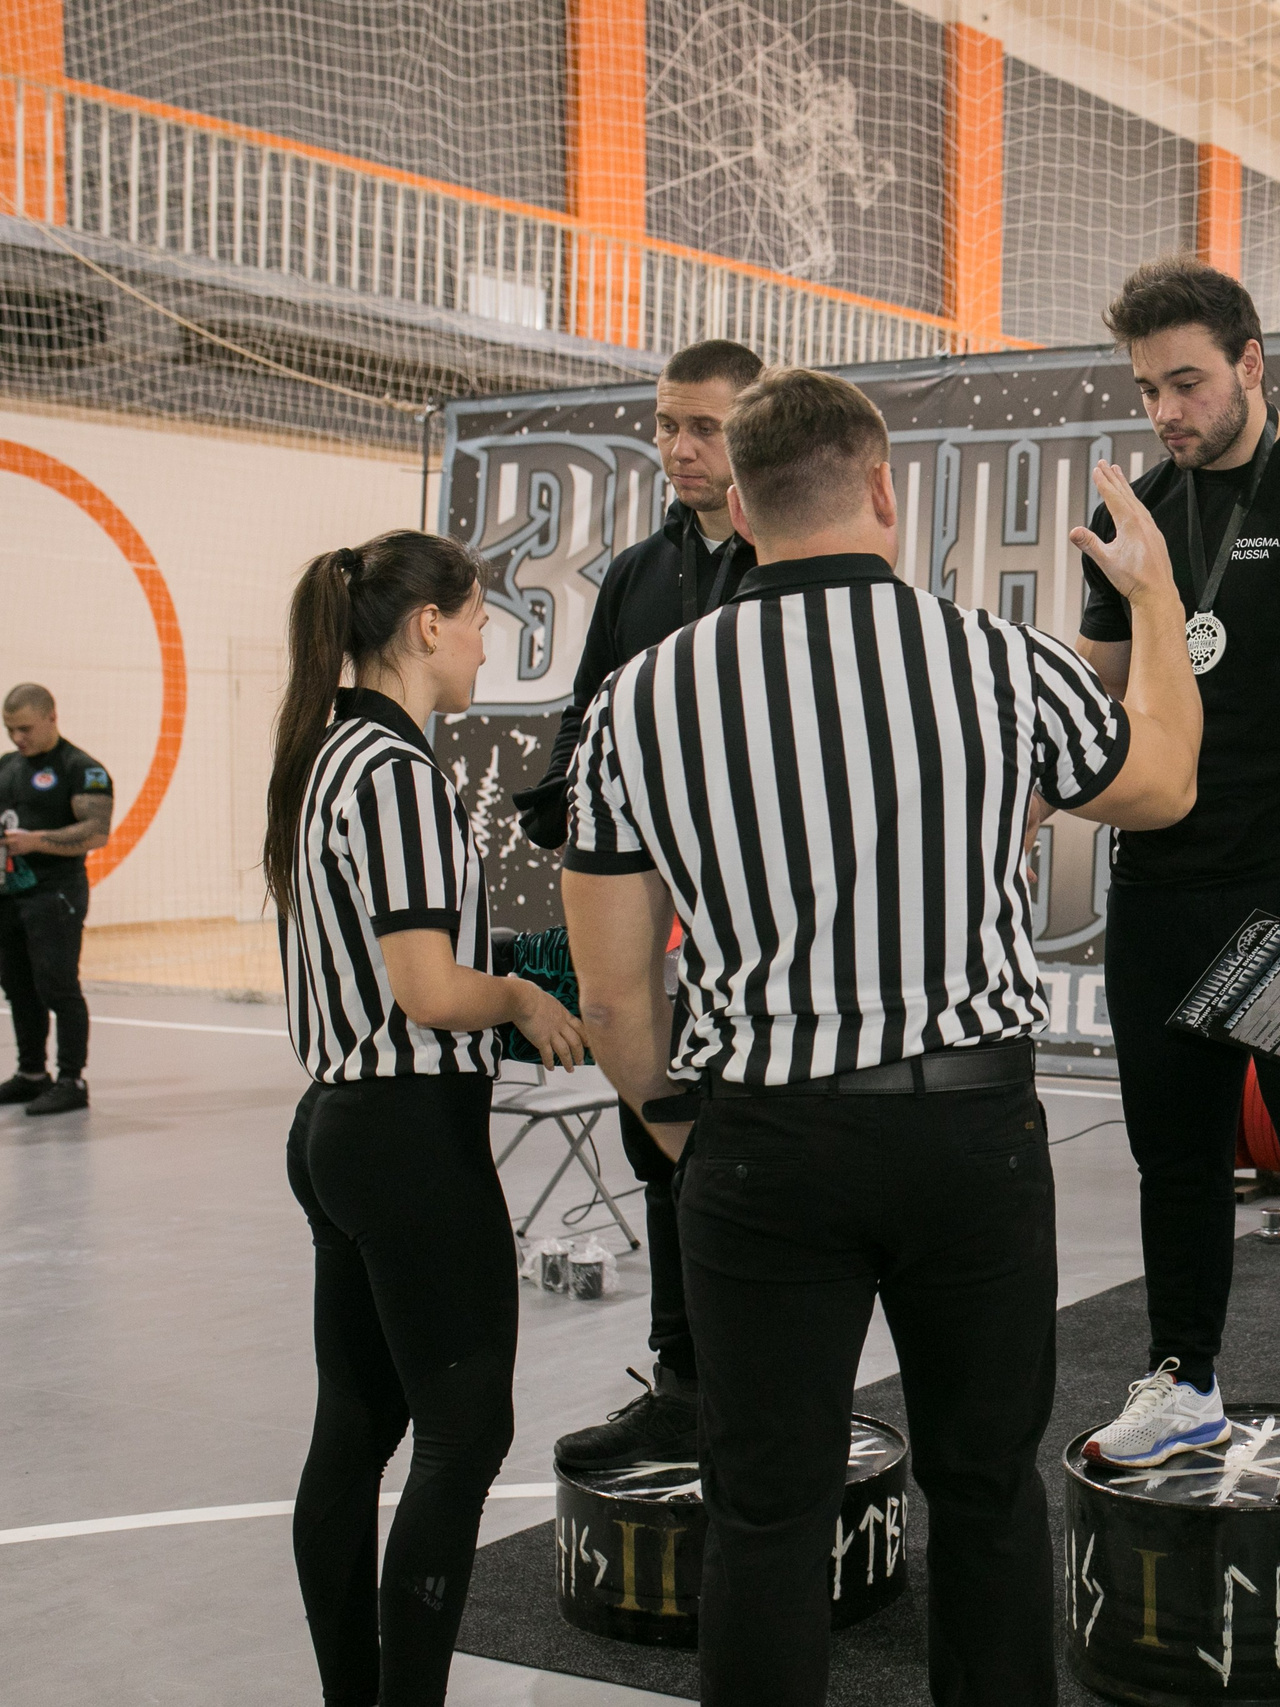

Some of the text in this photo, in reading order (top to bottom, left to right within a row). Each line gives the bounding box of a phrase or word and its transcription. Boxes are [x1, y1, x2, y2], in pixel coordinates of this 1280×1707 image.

[1231, 549, 1270, 561] RUSSIA
[1193, 923, 1280, 1028] ТУРНИР ПО СИЛОВЫМ ВИДАМ СПОРТА
